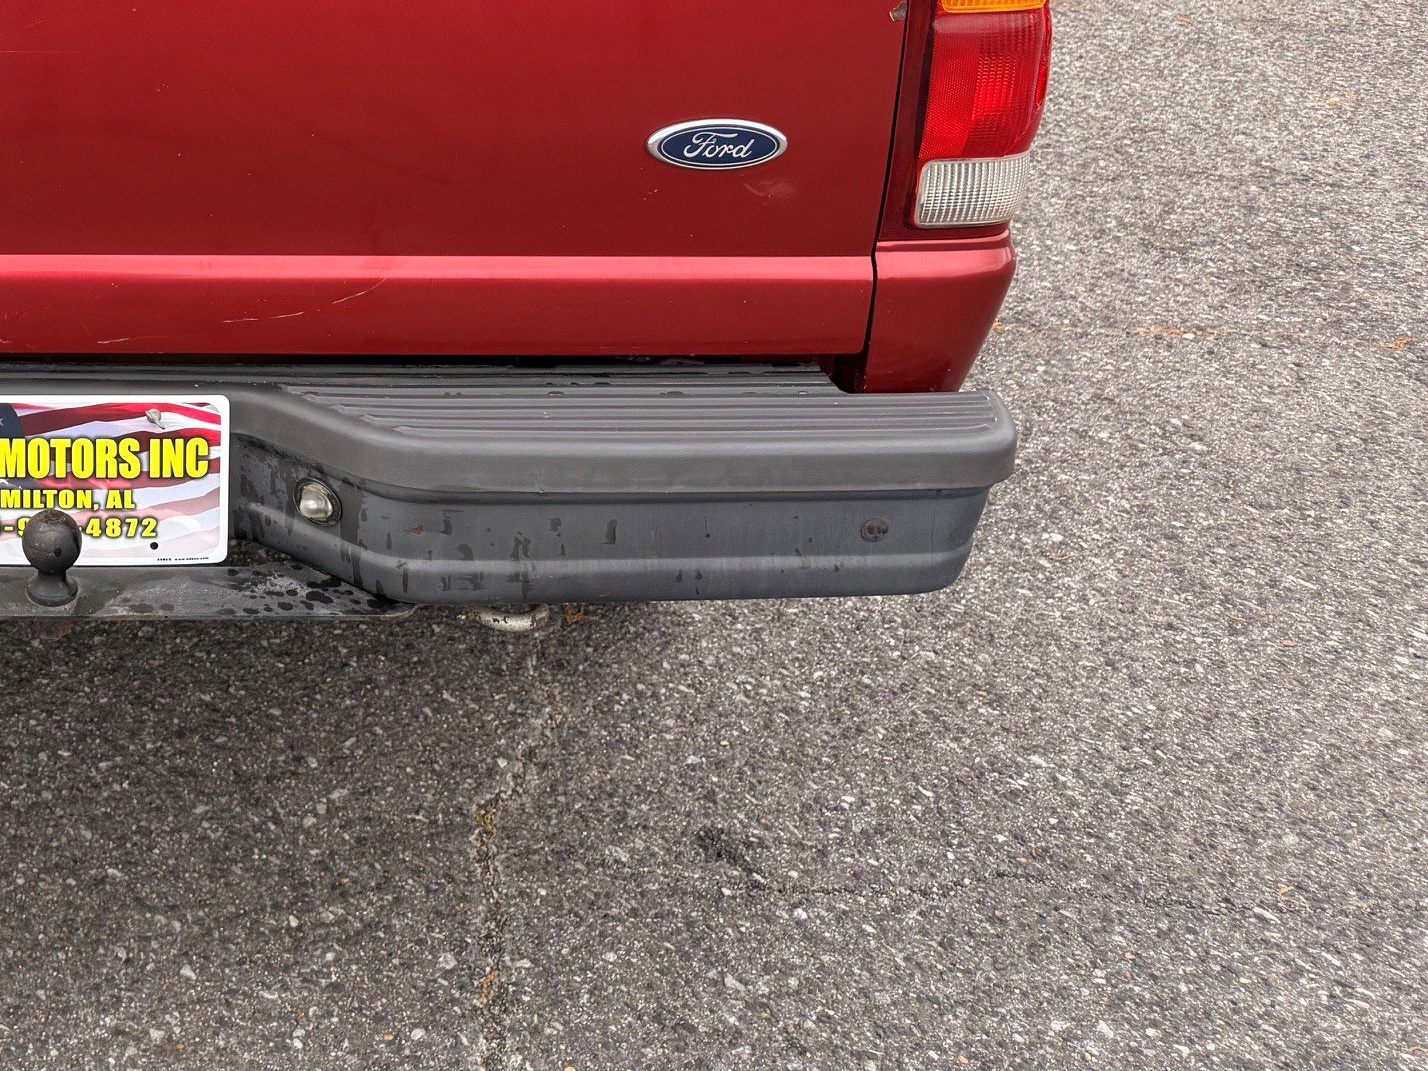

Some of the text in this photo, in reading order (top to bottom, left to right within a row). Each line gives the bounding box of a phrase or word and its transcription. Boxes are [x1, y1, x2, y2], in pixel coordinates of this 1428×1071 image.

[683, 131, 755, 158] Ford
[149, 437, 210, 479] INC
[105, 489, 136, 509] AL
